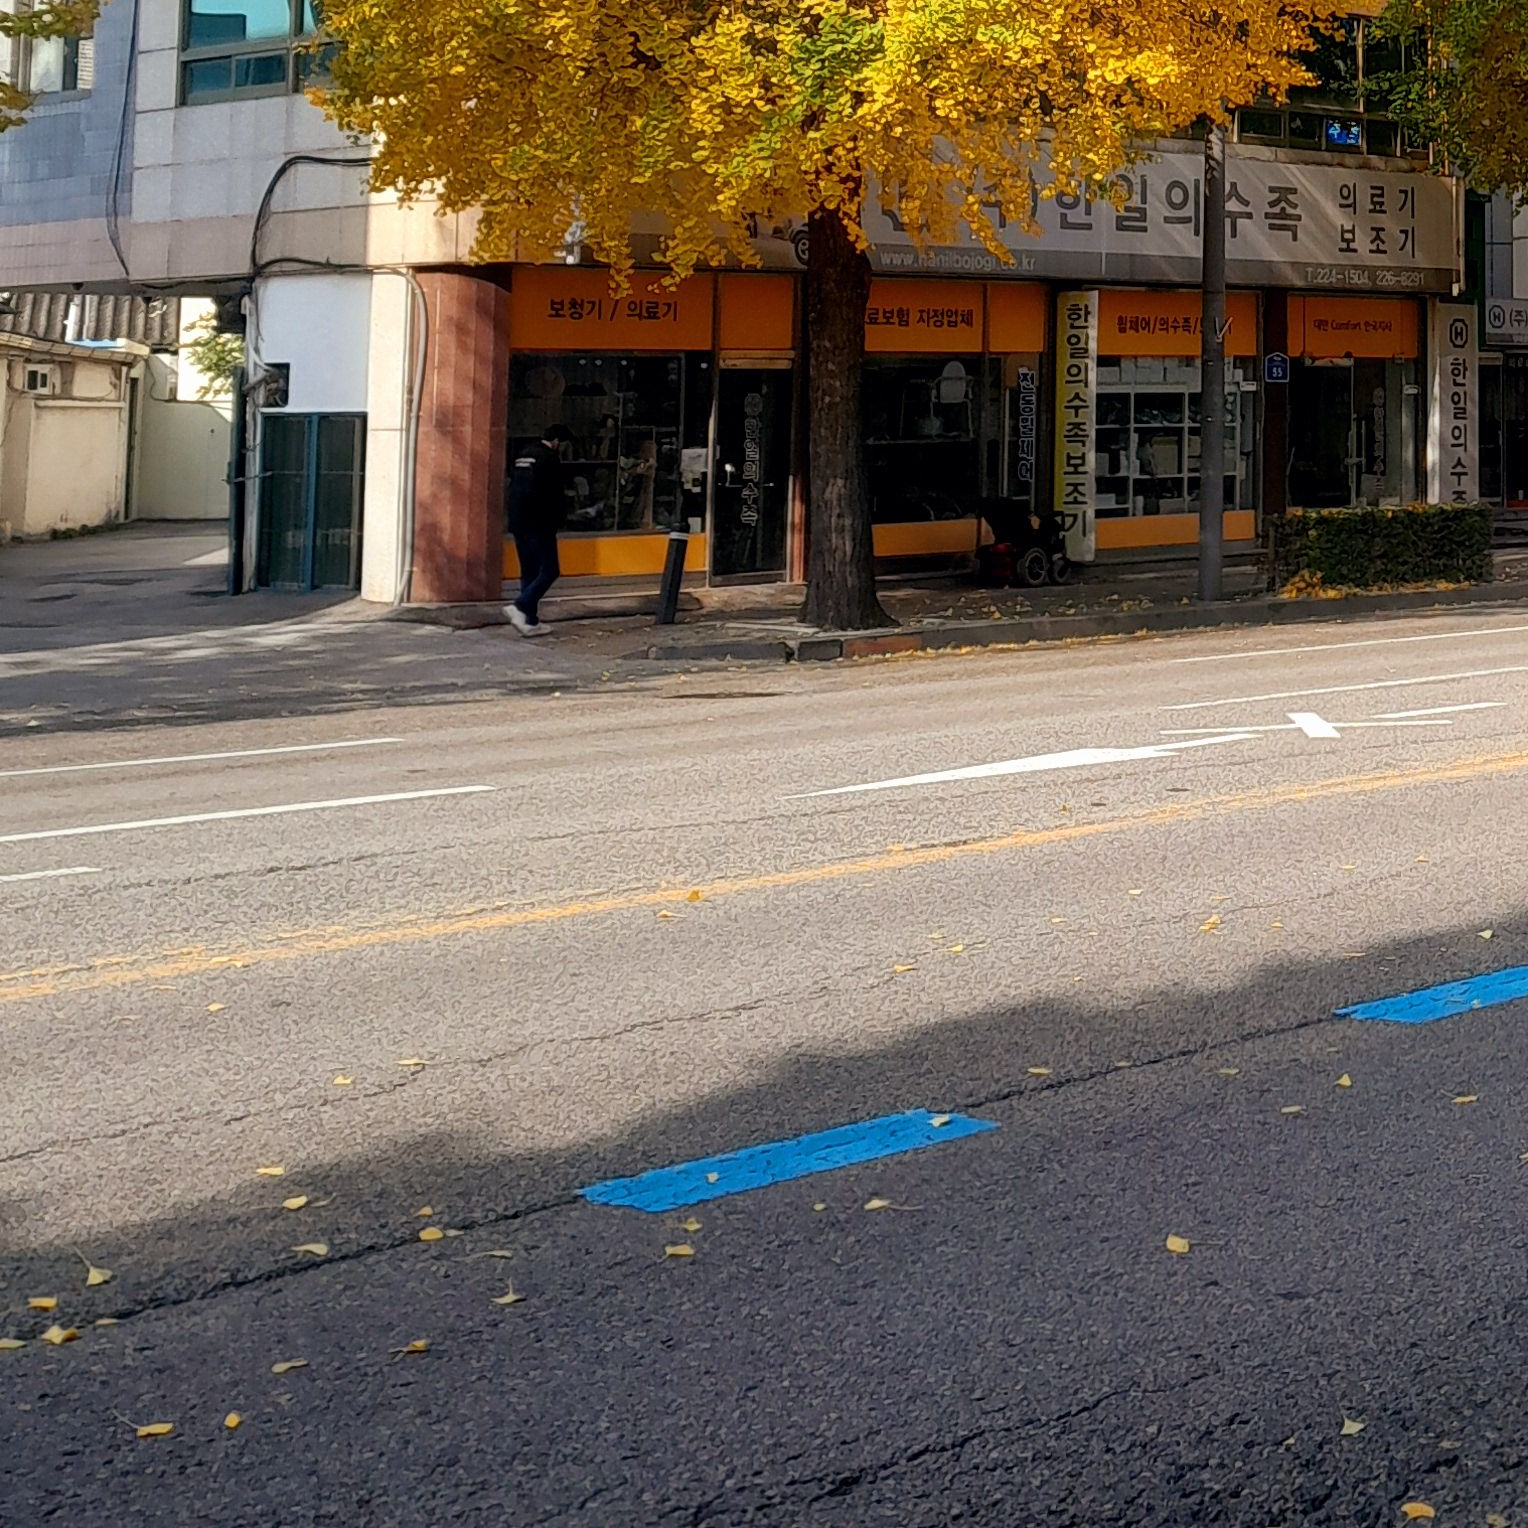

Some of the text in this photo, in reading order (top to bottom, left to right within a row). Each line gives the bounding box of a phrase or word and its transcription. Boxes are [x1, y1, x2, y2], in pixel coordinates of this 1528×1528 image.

[1338, 182, 1415, 219] 의료기
[1338, 223, 1416, 259] 보조기
[548, 298, 602, 320] 보청기
[625, 299, 678, 322] 의료기
[865, 307, 973, 328] 료보험 지정업체
[1062, 304, 1090, 538] 한일의수족보조기
